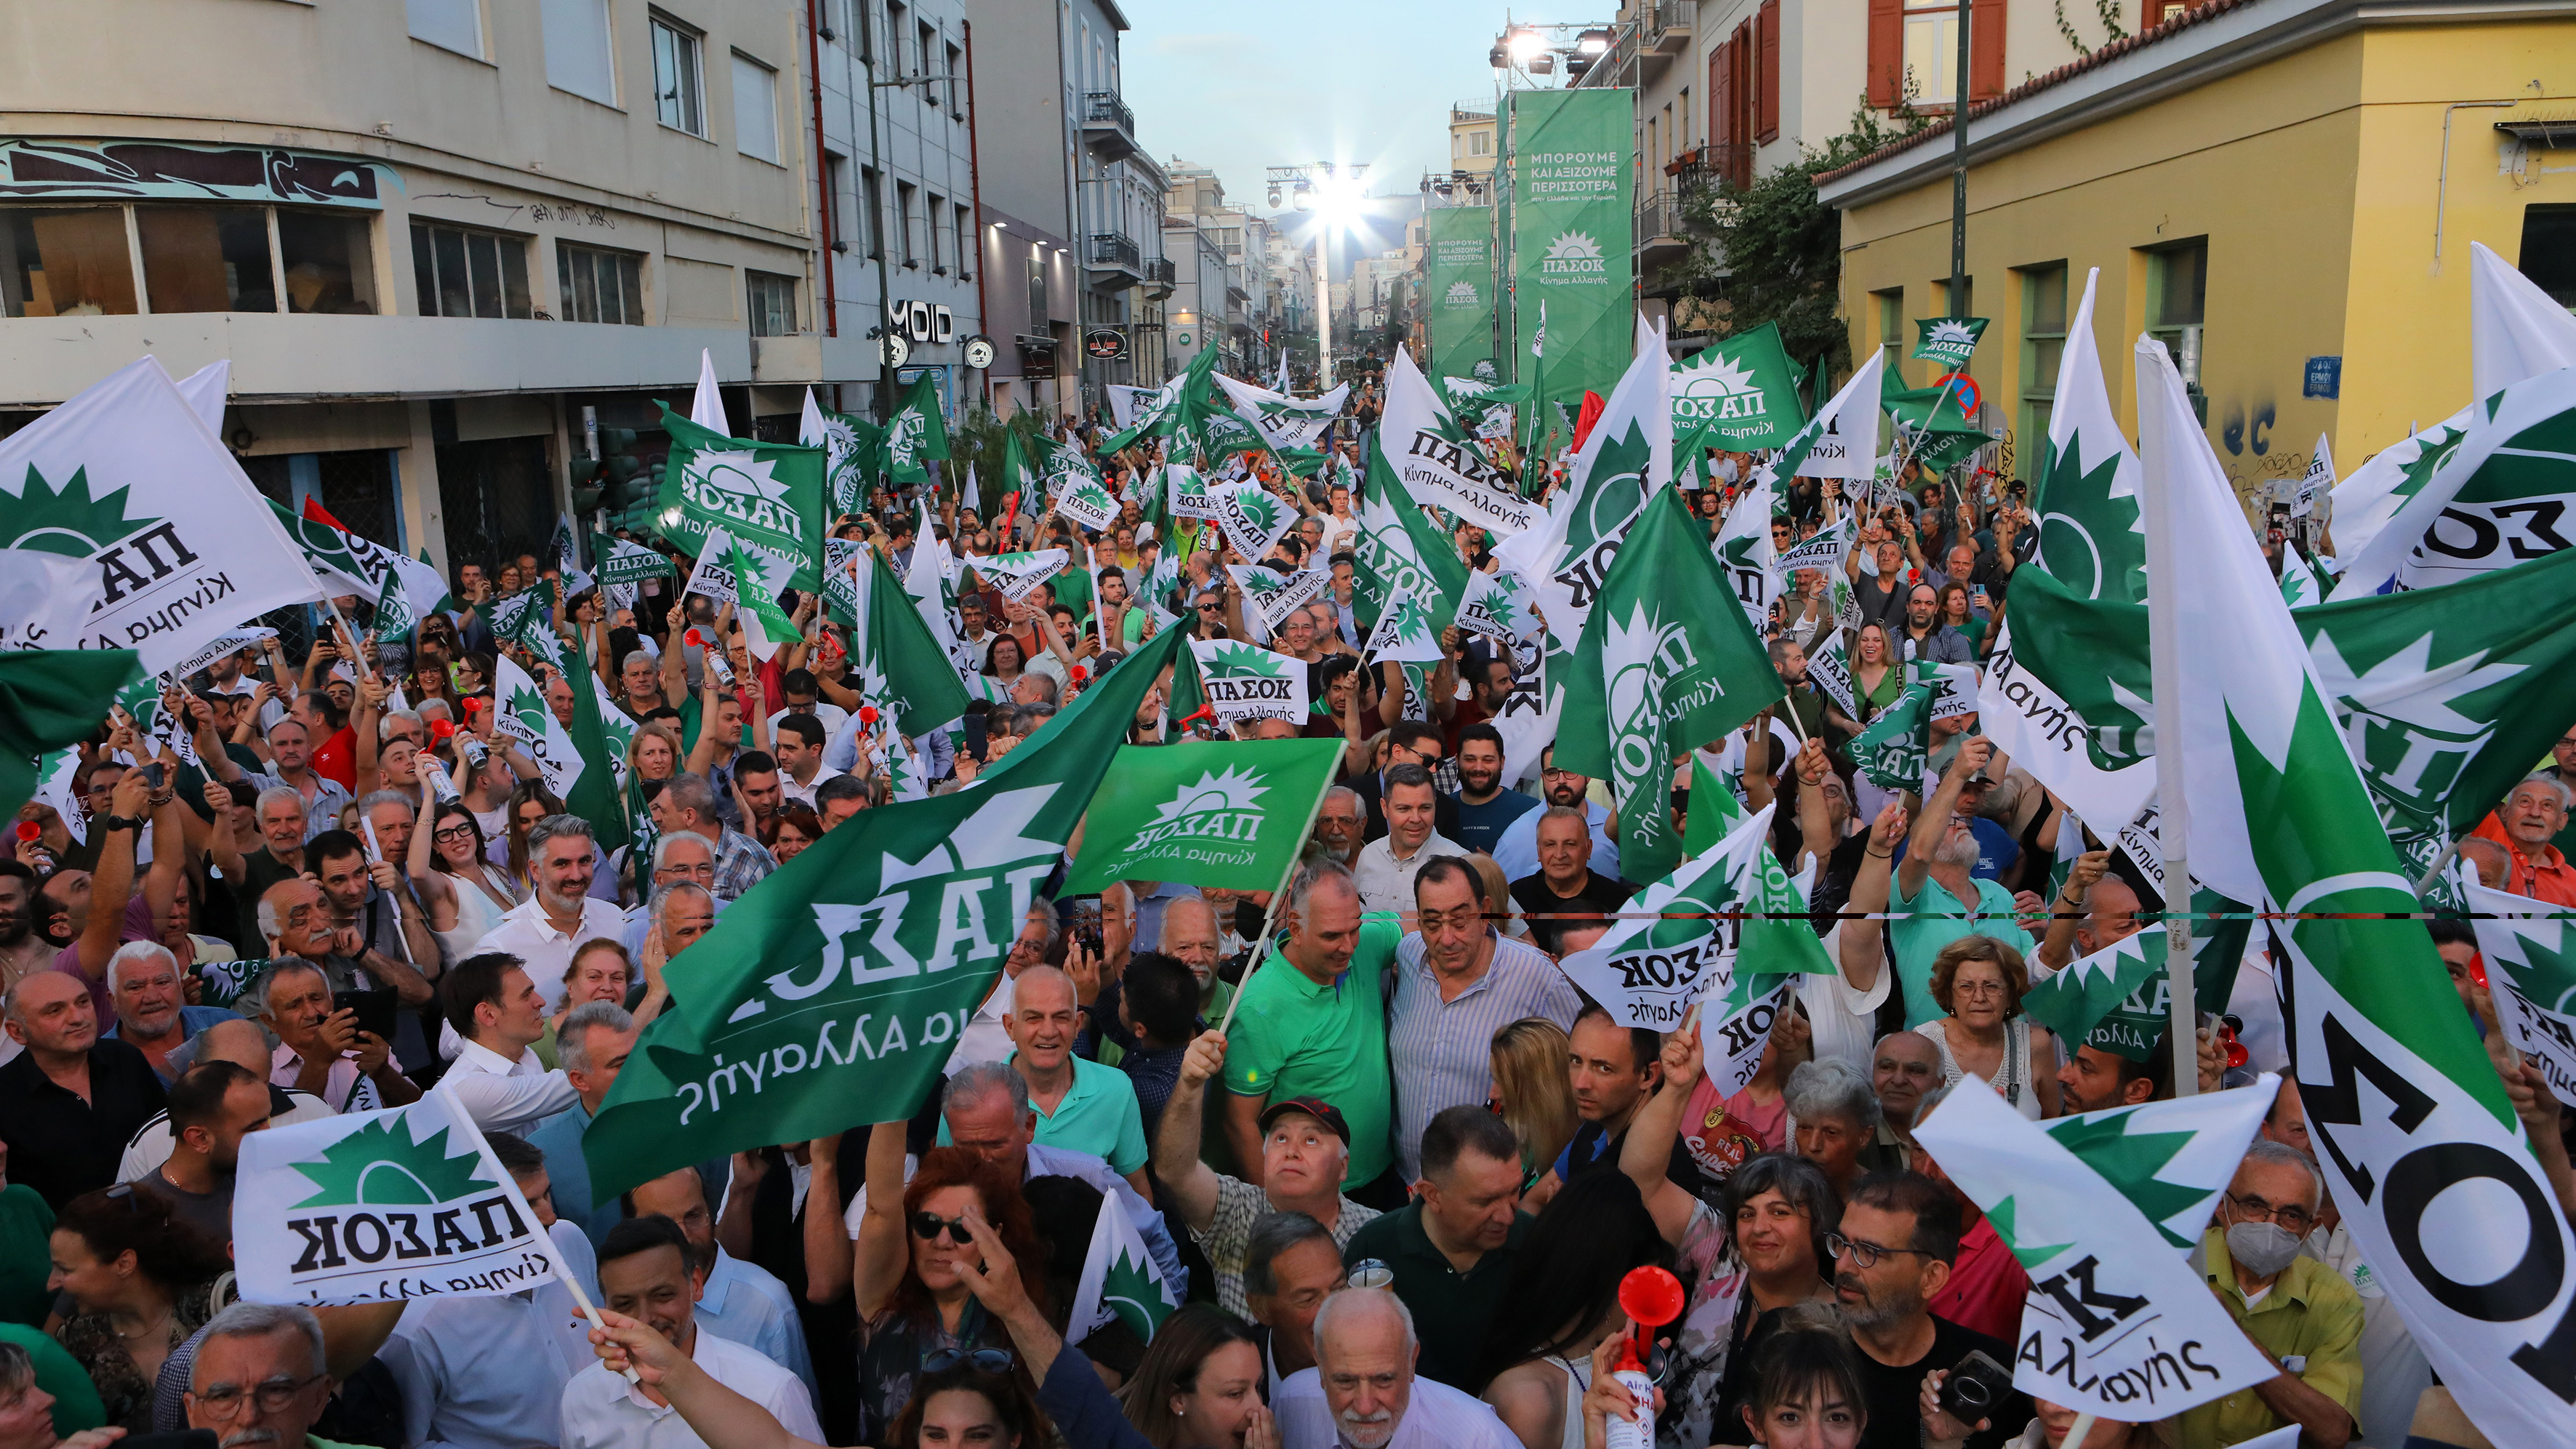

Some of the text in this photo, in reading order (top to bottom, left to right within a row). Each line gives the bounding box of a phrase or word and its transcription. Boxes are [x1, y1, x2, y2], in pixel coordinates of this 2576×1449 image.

[1531, 152, 1617, 164] ΜΠΟΡΟΥΜΕ
[1531, 166, 1617, 178] ΚΑΙ ΑΞΙΖΟΥΜΕ
[1531, 180, 1617, 192] ΠΕΡΙΣΣΟΤΕΡΑ
[1541, 260, 1605, 273] ΠΑΣΟΚ
[1540, 275, 1608, 286] Κίνημα Αλλαγής
[2311, 372, 2332, 382] ΕΡΜΟΥ
[2309, 383, 2331, 392] ERMOU
[1277, 420, 1308, 442] νημα
[1408, 431, 1528, 505] ΠΑΣΟ
[1404, 464, 1531, 530] Κίνημα Αλλαγής
[1060, 505, 1103, 529] Κίνημα Αλλαγής
[1066, 495, 1109, 521] ΠΑΣΟΚ
[606, 554, 666, 572] ΠΑΣΟΚ
[603, 568, 669, 583] Κίνημα Αλλαγής
[700, 565, 738, 590] ΠΑΣ
[1355, 533, 1443, 614] ΑΣΟΚ
[1009, 585, 1027, 601] νημα
[1268, 608, 1286, 624] νημα
[1285, 574, 1325, 609] Αλλαγής
[822, 590, 858, 622] Κίνημα Αλλα
[1458, 617, 1495, 635] Κίνημα
[521, 633, 547, 659] Κίνημα
[1810, 662, 1831, 686] ίνημα
[1205, 679, 1293, 702] ΠΑΣΟΚ
[1216, 709, 1247, 721] νημα
[1930, 701, 1967, 716] αγής
[2118, 827, 2165, 884] Κίνημα
[1716, 1138, 1741, 1161] REAL
[1626, 1380, 1642, 1390] Air
